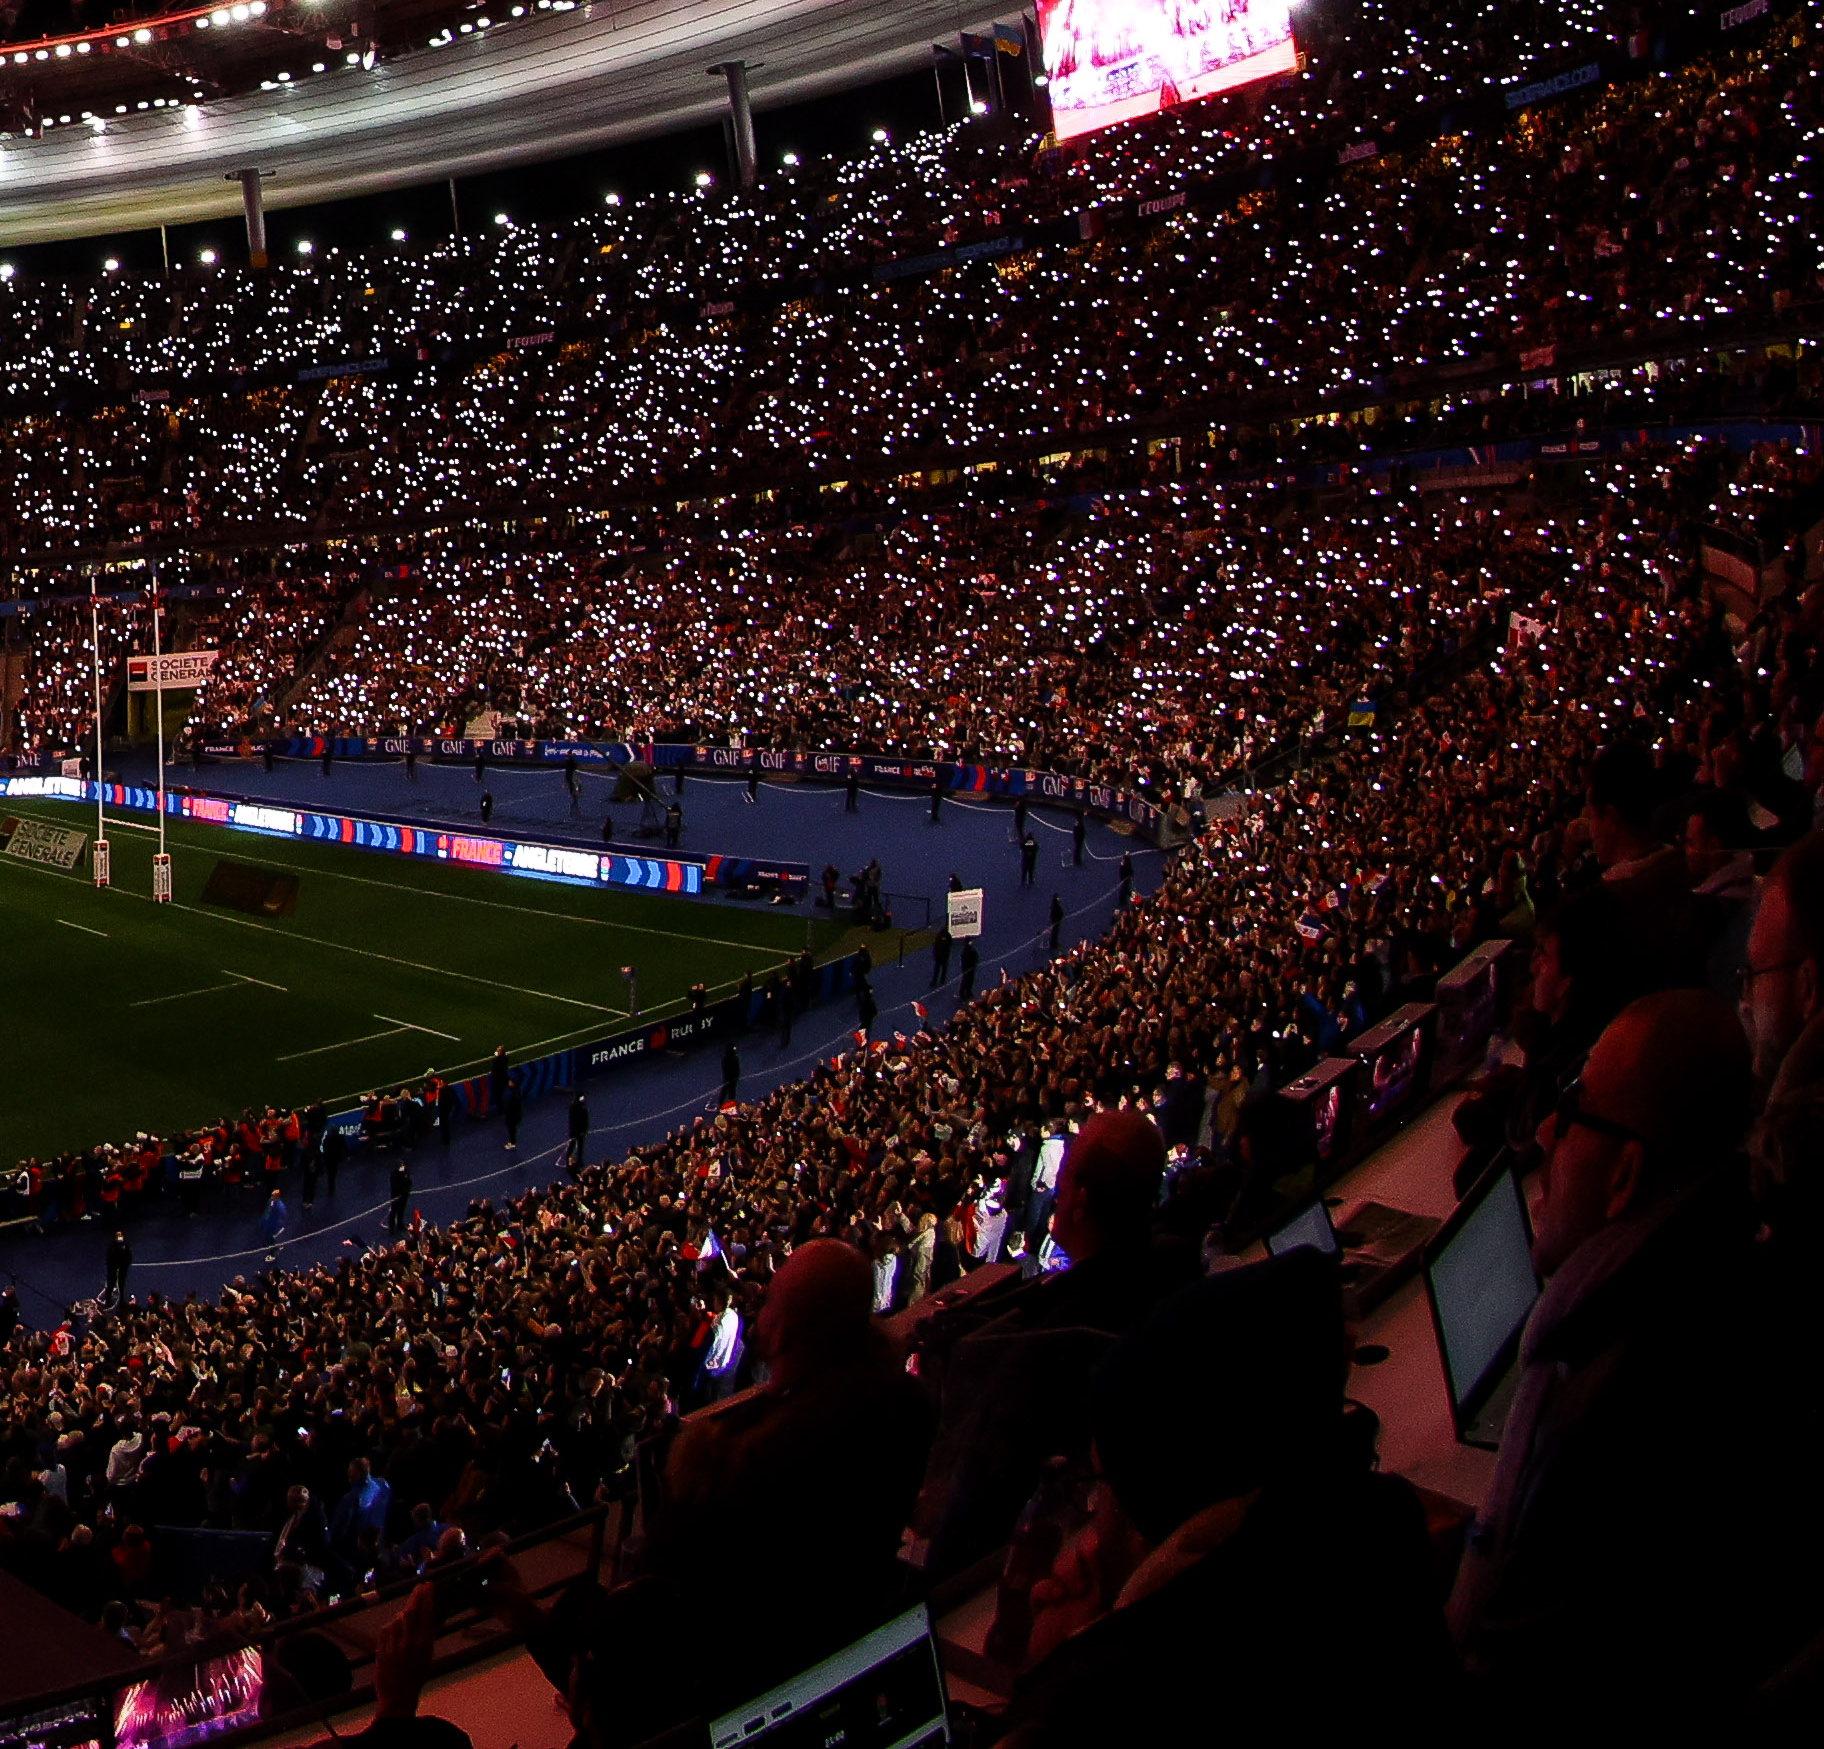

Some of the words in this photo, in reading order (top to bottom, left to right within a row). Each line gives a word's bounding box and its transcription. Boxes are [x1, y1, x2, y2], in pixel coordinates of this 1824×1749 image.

[384, 738, 412, 754] GMF
[441, 739, 466, 755] GMF
[491, 741, 517, 757] GMF
[713, 749, 740, 766] GMF
[760, 750, 787, 768] GMF
[192, 798, 229, 821] FRANCE
[451, 836, 503, 865] FRANCE
[591, 1038, 644, 1065] FRANCE
